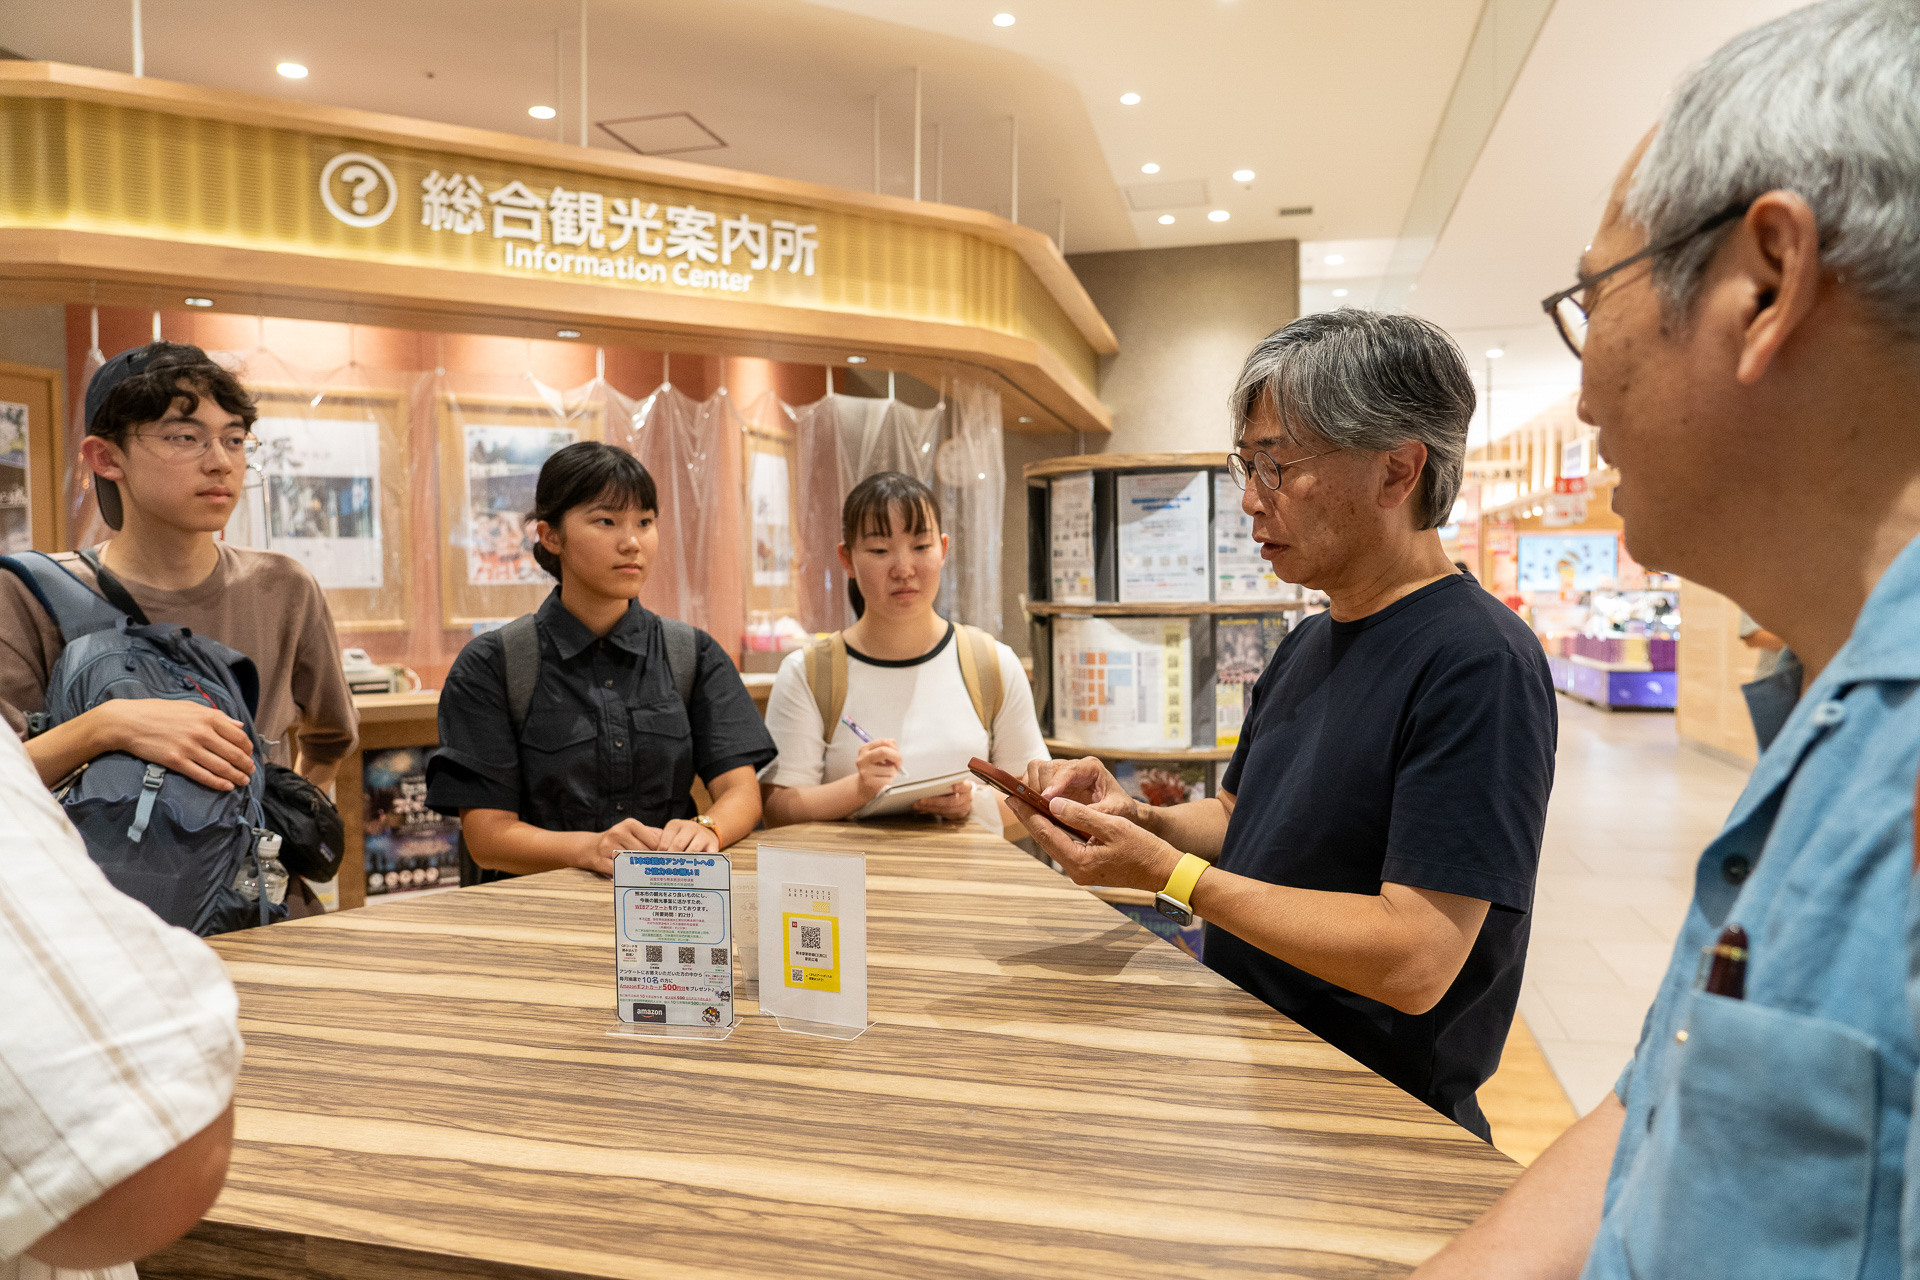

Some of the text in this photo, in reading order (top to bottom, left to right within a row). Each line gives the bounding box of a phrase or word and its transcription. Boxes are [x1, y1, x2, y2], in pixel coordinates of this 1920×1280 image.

[420, 170, 819, 277] 総合観光案内所
[504, 241, 754, 293] Information Center
[636, 1008, 663, 1016] amazon
